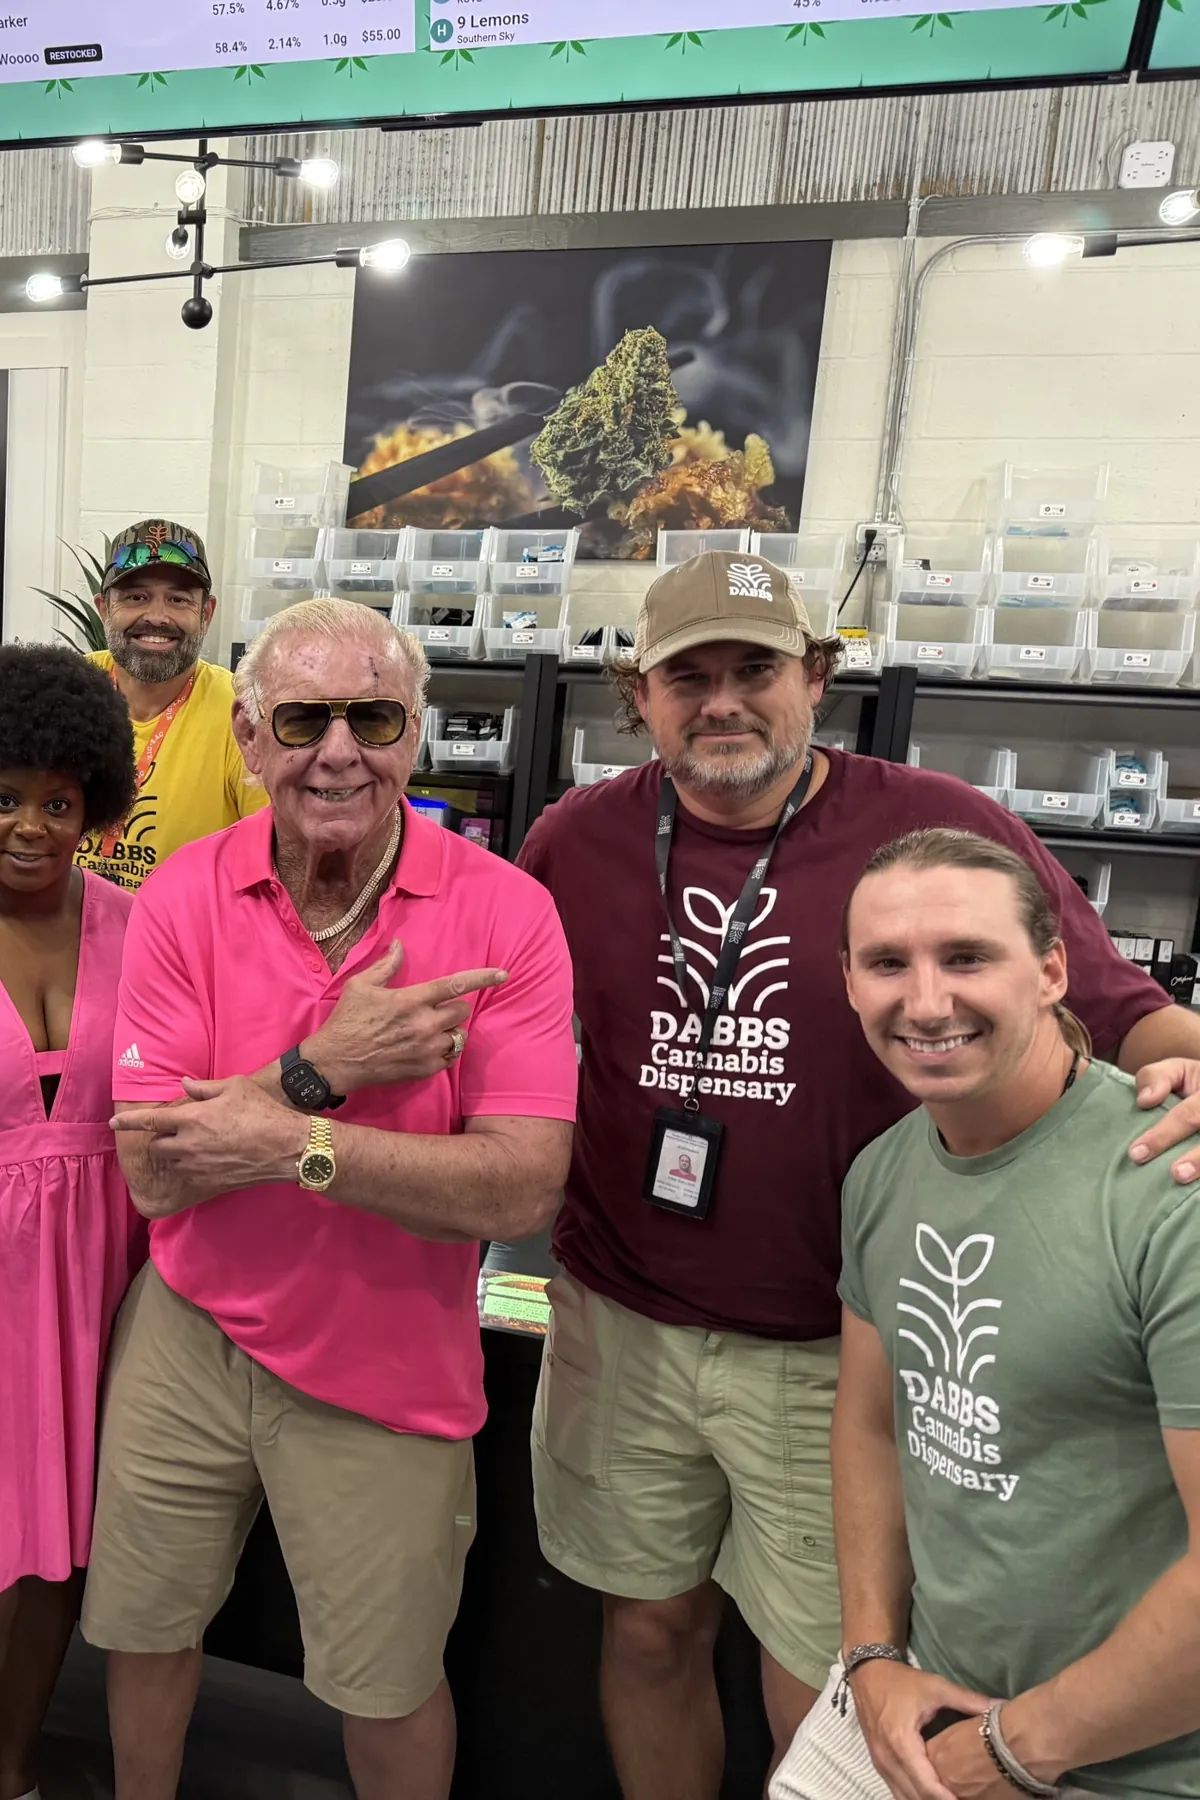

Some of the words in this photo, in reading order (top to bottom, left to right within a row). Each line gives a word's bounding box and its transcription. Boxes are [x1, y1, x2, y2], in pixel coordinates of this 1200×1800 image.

[212, 3, 245, 16] 57.5%
[266, 0, 300, 11] 4.67%
[457, 16, 466, 29] 9
[470, 13, 529, 28] Lemons
[215, 41, 248, 54] 58.4%
[268, 37, 302, 50] 2.14%
[323, 33, 347, 46] 1.0g
[361, 28, 401, 43] $55.00
[457, 34, 497, 44] Southern
[499, 31, 515, 42] Sky
[49, 48, 98, 61] RESTOCKED
[650, 1010, 791, 1050] DABBS
[117, 1058, 145, 1069] adidas
[651, 1041, 785, 1076] Cannabis
[638, 1064, 797, 1107] Dispensary
[899, 1369, 1001, 1435] DABBS
[912, 1405, 1002, 1465] Cannabis
[907, 1429, 1020, 1502] Dispensary
